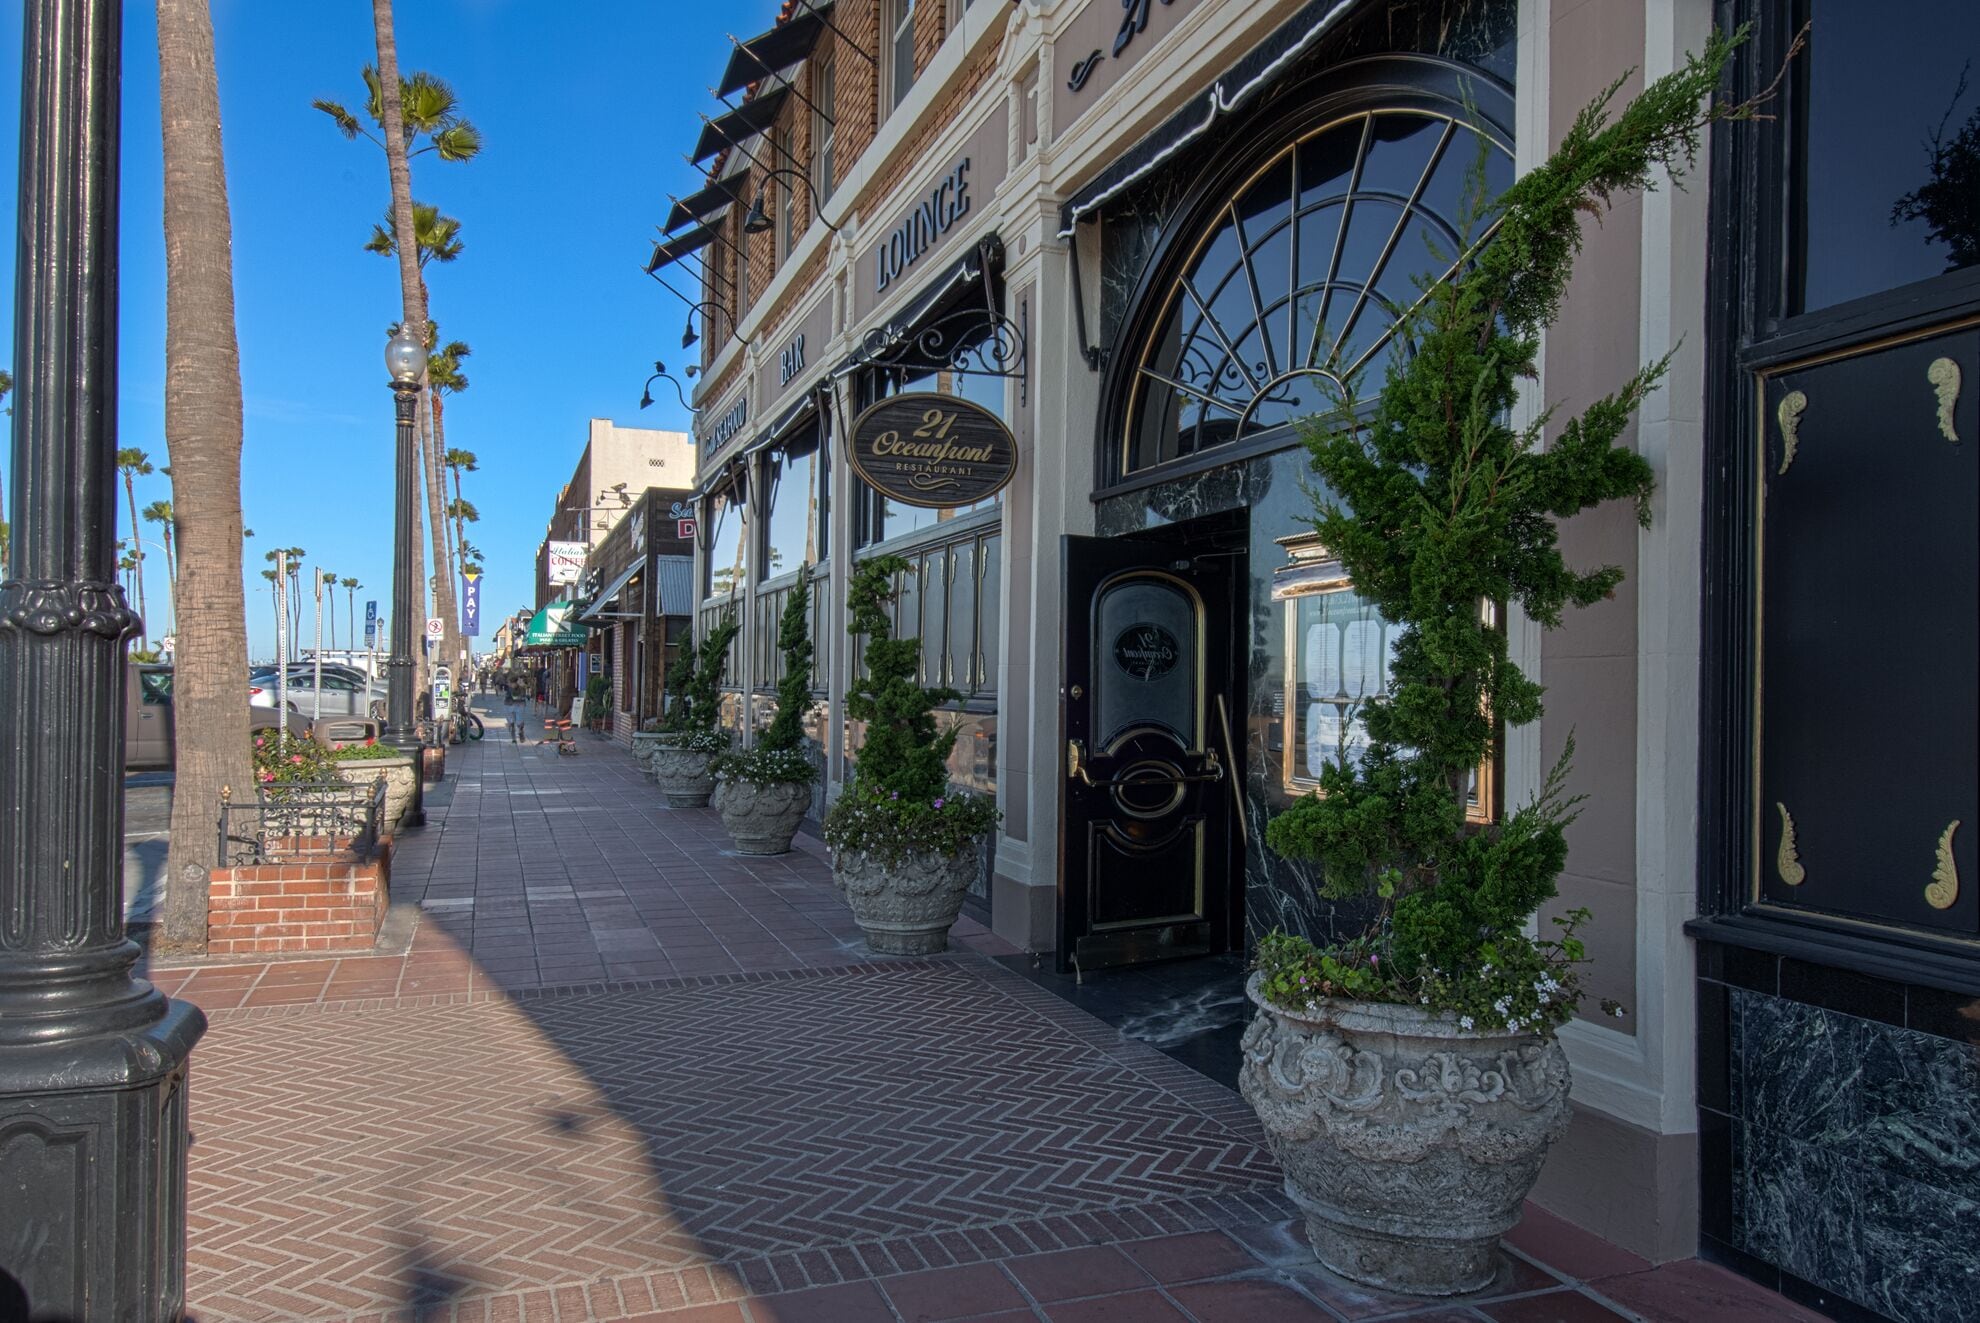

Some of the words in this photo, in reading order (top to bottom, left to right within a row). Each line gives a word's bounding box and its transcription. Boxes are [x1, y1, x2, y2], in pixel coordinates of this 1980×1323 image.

[877, 157, 970, 292] LOUNGE
[780, 334, 805, 387] BAR
[714, 399, 746, 449] SEAFOOD
[912, 409, 959, 439] 21
[872, 430, 993, 465] Oceanfront
[896, 463, 973, 476] RESTAURANT
[466, 586, 477, 619] PAY
